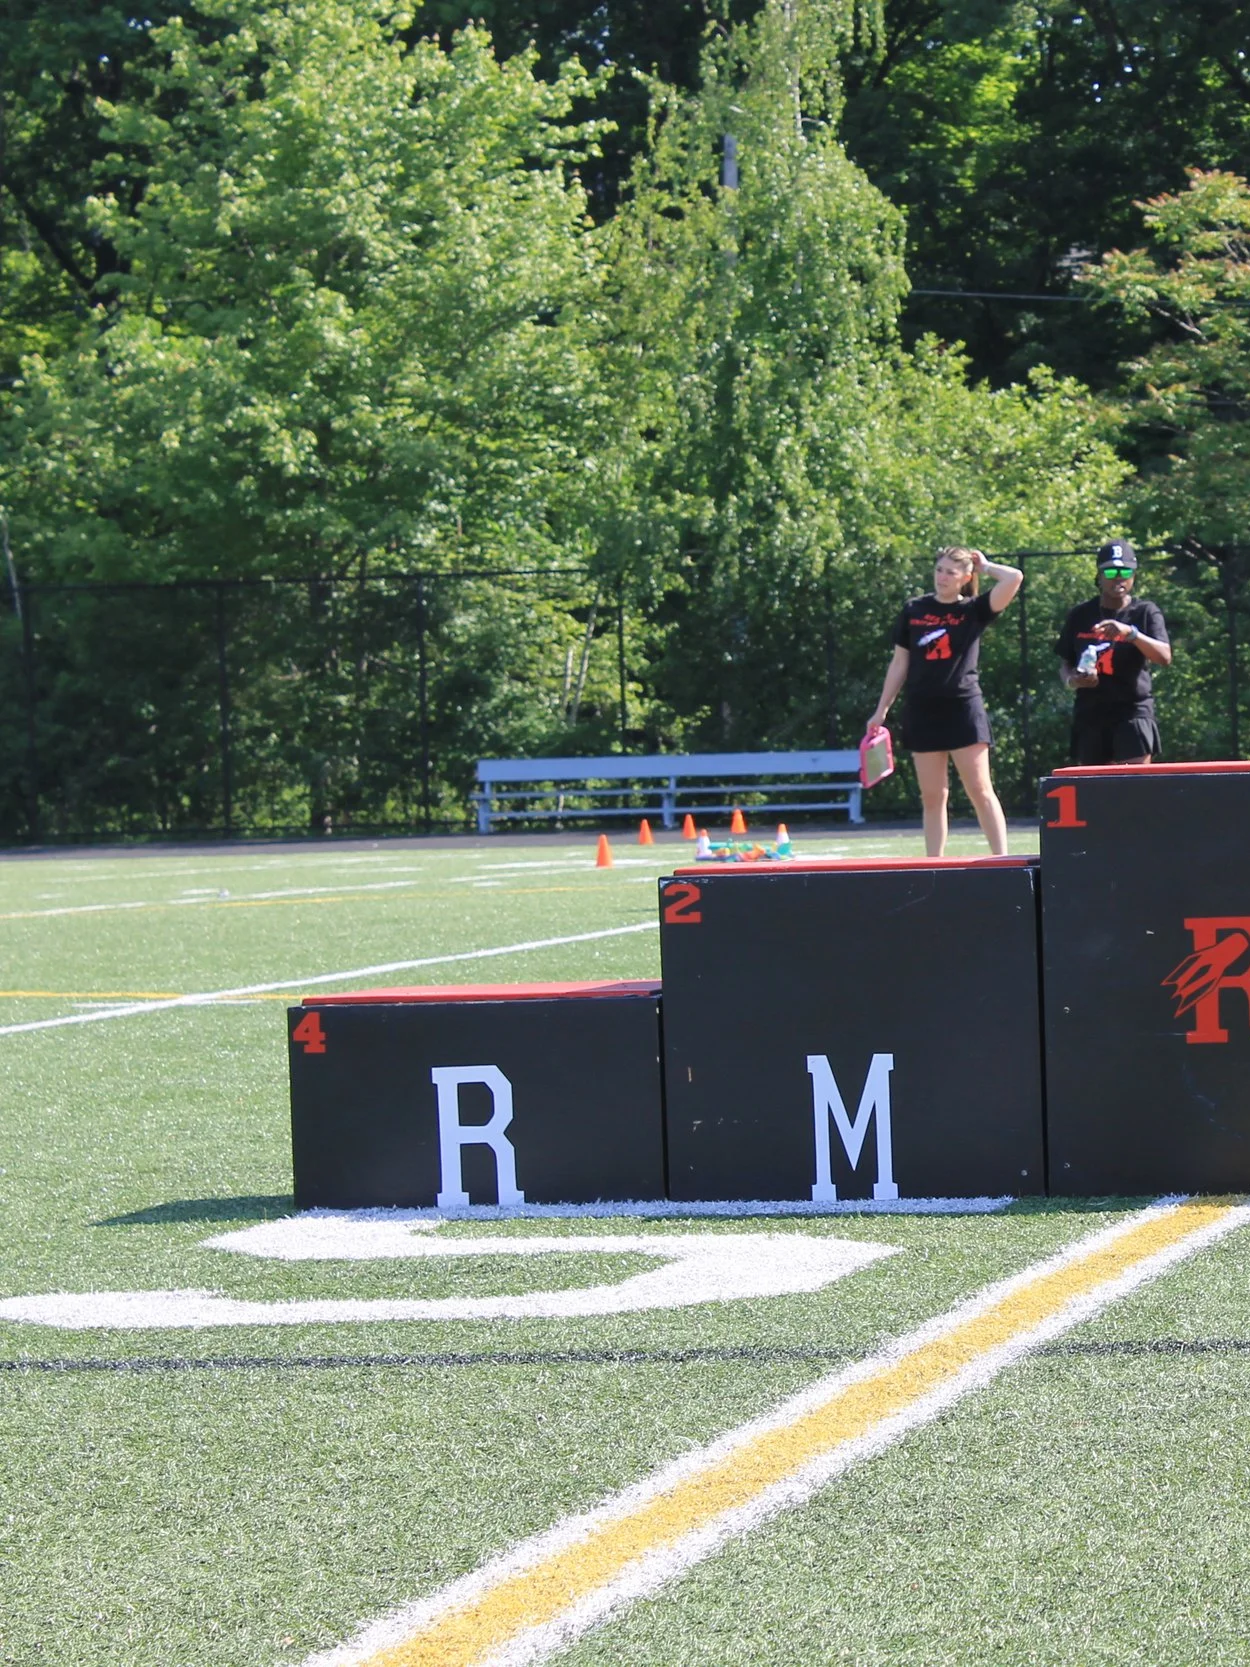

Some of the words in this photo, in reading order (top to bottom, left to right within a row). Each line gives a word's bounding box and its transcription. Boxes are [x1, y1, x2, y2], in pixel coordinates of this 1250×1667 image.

[1112, 545, 1123, 559] B
[1046, 785, 1087, 828] 1
[664, 883, 702, 924] 2
[292, 1011, 327, 1054] 4
